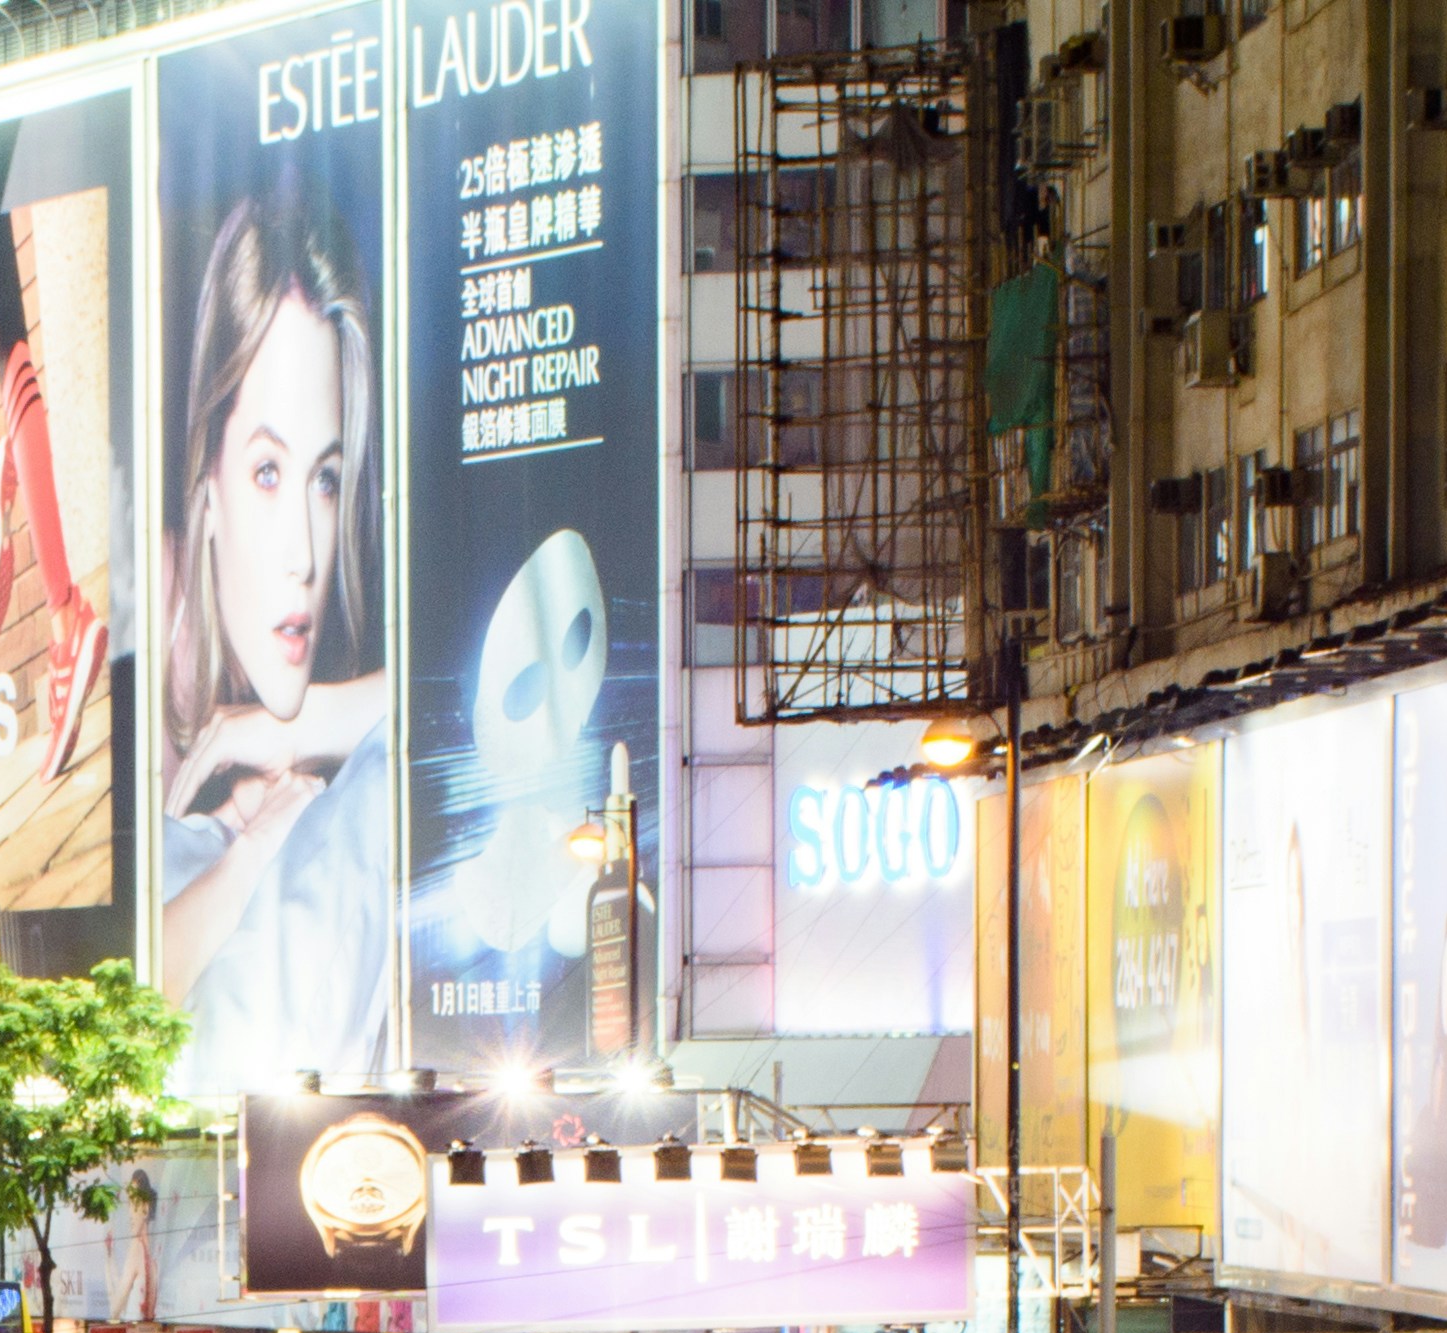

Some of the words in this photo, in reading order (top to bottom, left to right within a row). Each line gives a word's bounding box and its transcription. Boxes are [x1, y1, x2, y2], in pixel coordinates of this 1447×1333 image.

[412, 0, 594, 109] LAUDER
[459, 121, 603, 199] 25倍極速滲透
[459, 187, 603, 260] 半瓶皇牌精華
[460, 268, 532, 318] 全球首創
[461, 304, 576, 361] ADVANCED
[461, 363, 528, 406] NIGHT
[531, 346, 601, 395] REPAIR
[788, 777, 961, 889] SOGO
[430, 981, 543, 1016] 1月1日隆重上市
[724, 1202, 921, 1262] 謝瑞麟
